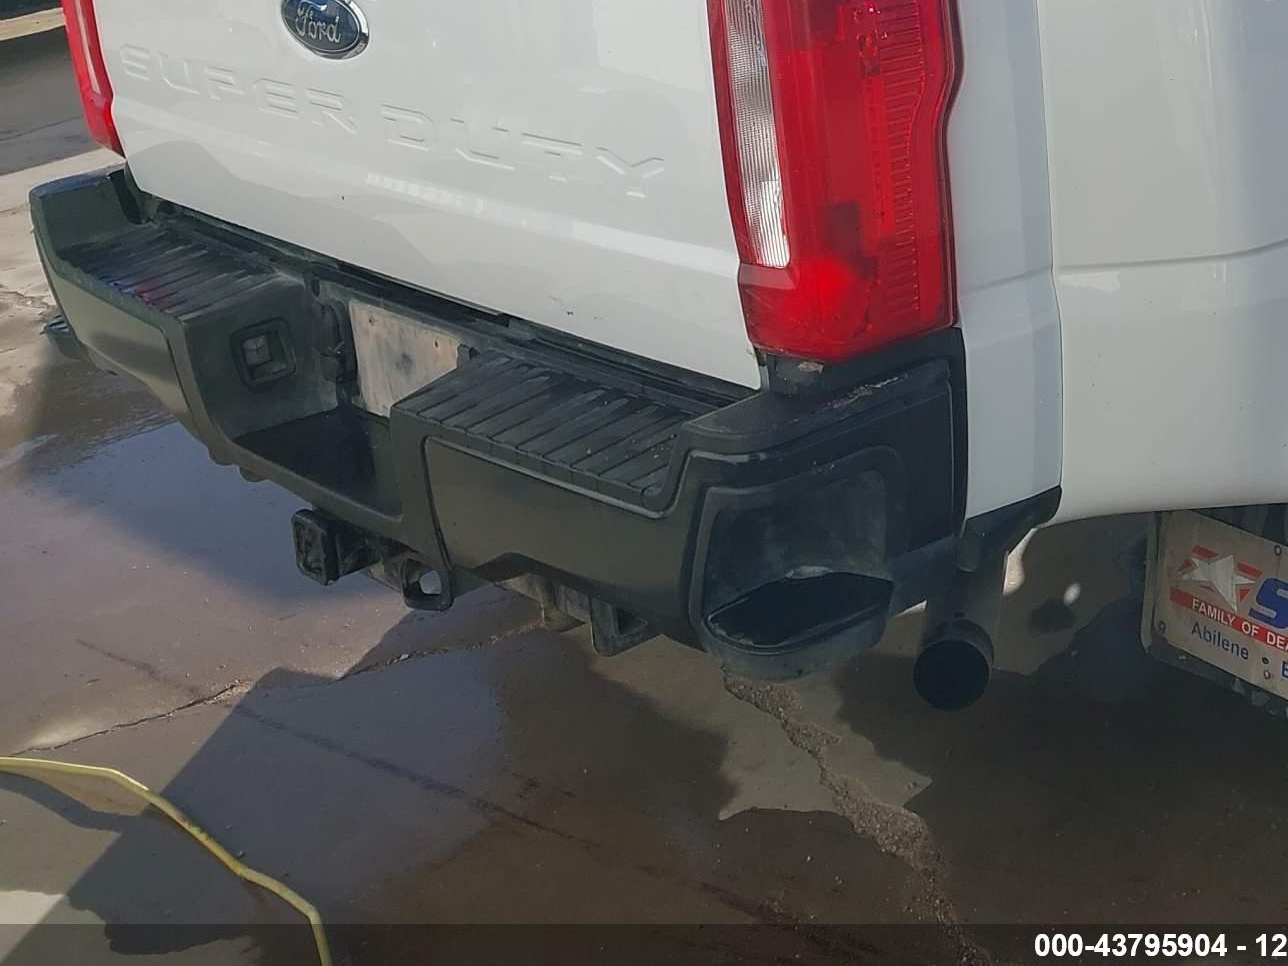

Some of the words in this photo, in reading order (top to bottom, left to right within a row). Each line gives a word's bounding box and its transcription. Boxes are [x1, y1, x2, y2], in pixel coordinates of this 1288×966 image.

[295, 0, 342, 43] Ford
[121, 43, 358, 135] SUPER
[379, 104, 664, 198] DUTY
[1191, 598, 1236, 626] FAMILY
[1241, 623, 1259, 638] OF
[1191, 622, 1249, 660] Abilene
